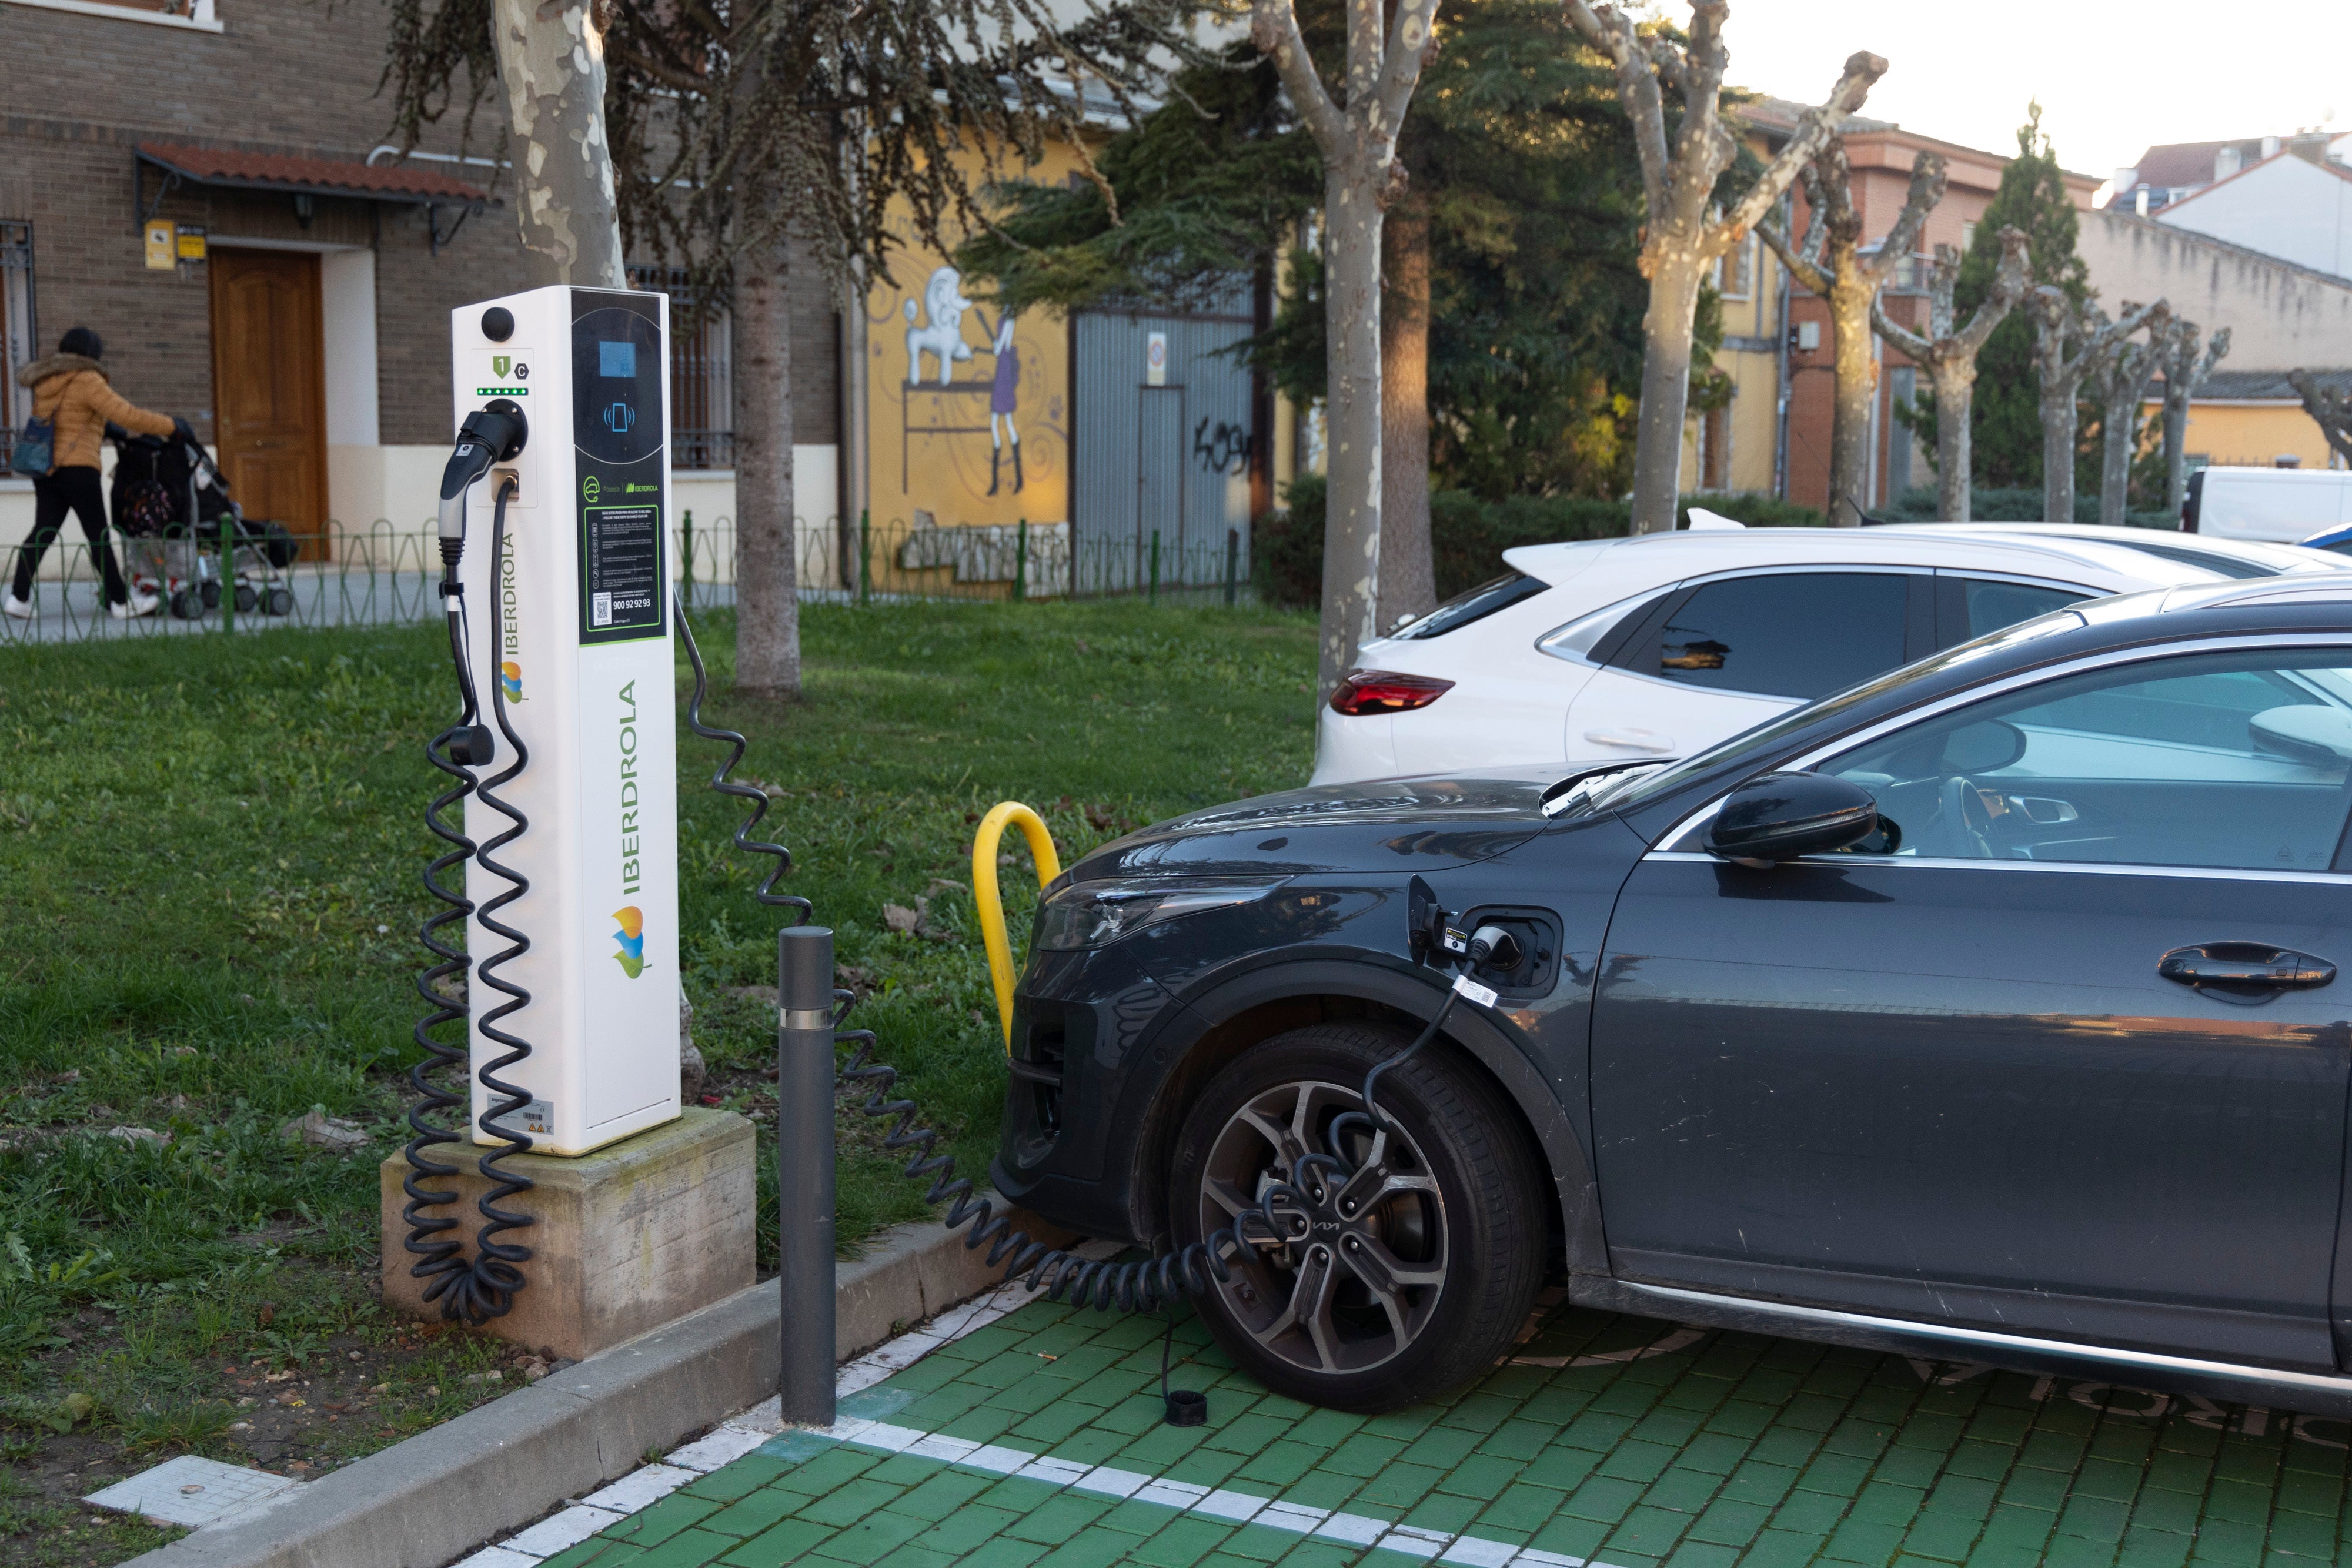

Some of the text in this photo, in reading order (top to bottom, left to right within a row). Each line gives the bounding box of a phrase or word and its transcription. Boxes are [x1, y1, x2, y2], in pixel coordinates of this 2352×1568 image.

[499, 358, 505, 372] 1
[517, 366, 526, 377] C
[502, 533, 518, 654] IBERDROLA
[613, 599, 650, 610] 900 92 92 93
[619, 678, 640, 895] IBERDROLA
